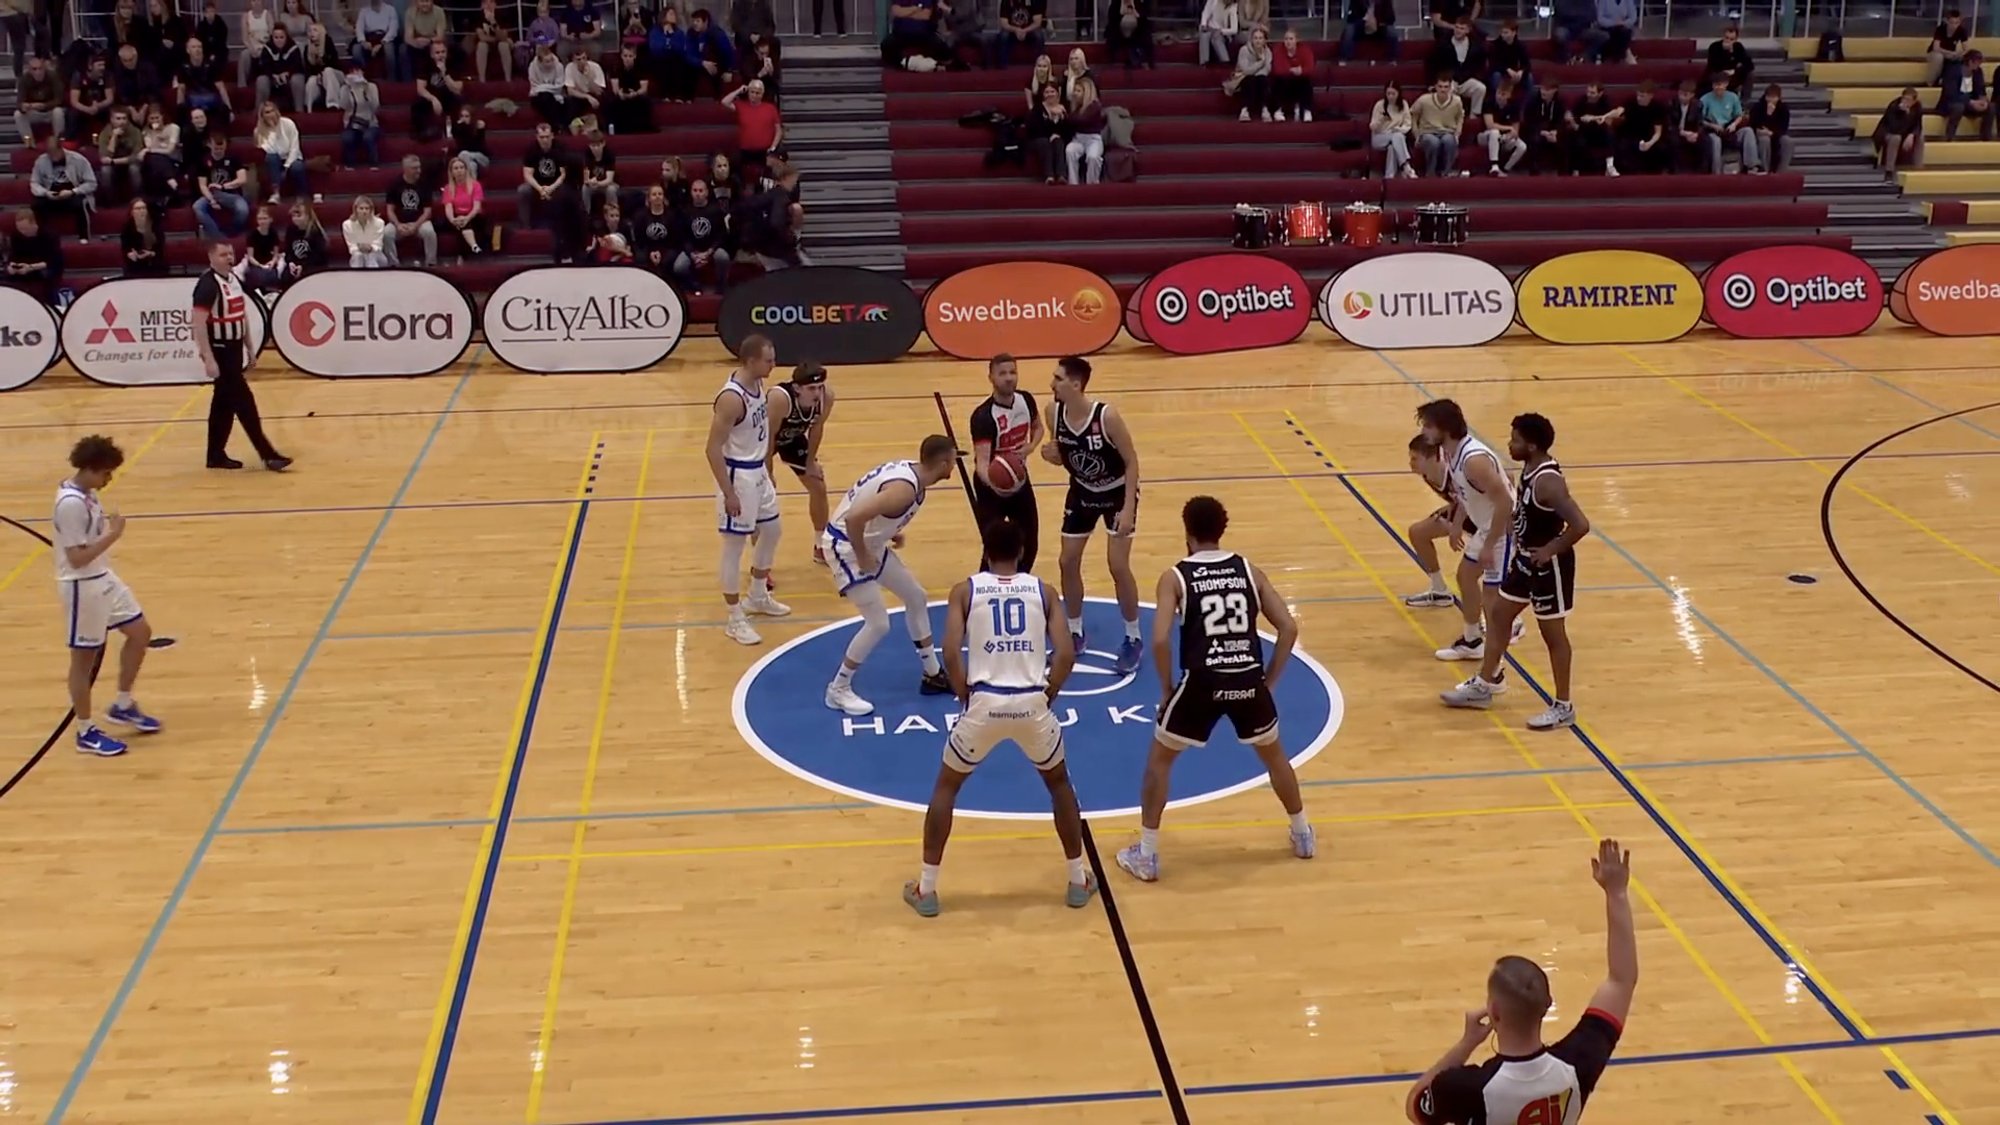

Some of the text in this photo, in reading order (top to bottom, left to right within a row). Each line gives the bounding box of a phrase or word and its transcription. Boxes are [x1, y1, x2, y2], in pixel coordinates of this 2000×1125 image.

[1197, 285, 1294, 319] Optibet
[1379, 290, 1503, 318] UTILITAS
[1542, 284, 1678, 309] RAMIRENT
[1765, 276, 1867, 308] Optibet
[343, 304, 453, 341] Elora
[502, 296, 670, 341] CityAlko
[751, 304, 856, 324] COOLBET
[938, 298, 1067, 322] Swedbank
[84, 347, 194, 364] Changes for the
[1086, 435, 1104, 450] 15
[1191, 576, 1247, 593] THOMPSON
[988, 598, 1026, 636] 10
[1201, 593, 1249, 636] 23
[997, 640, 1034, 652] STEEL
